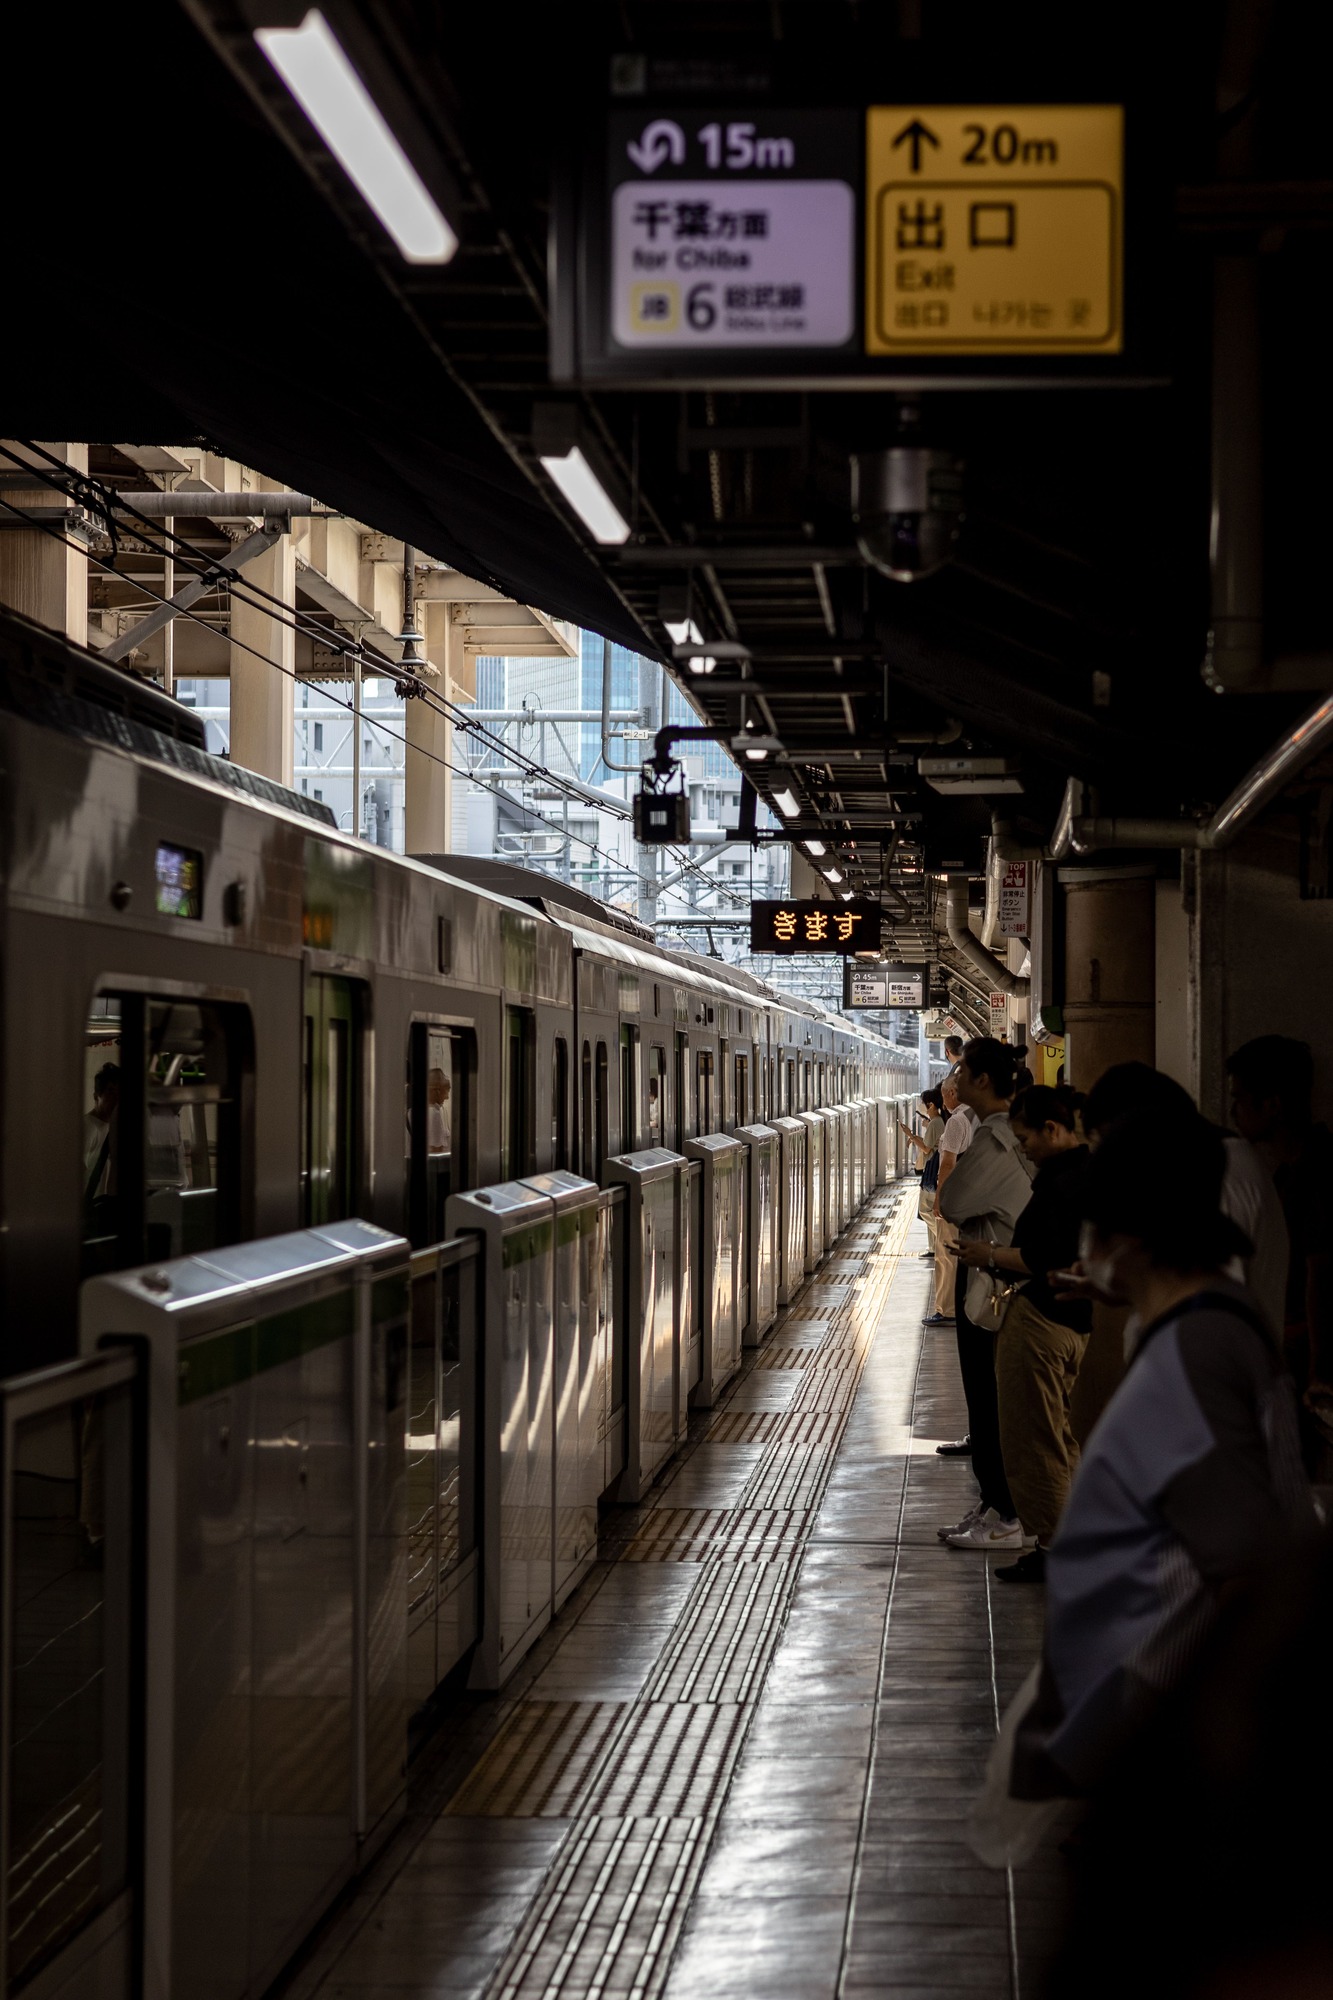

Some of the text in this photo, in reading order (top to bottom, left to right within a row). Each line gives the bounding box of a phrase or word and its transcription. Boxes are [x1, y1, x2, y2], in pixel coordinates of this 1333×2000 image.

[698, 122, 795, 170] 15m
[961, 122, 1059, 166] 20m
[632, 200, 770, 241] 千葉方面
[633, 245, 753, 271] for Chiba
[895, 260, 956, 292] Exit
[684, 281, 718, 333] 6
[774, 911, 862, 940] きます
[898, 996, 904, 1004] 5
